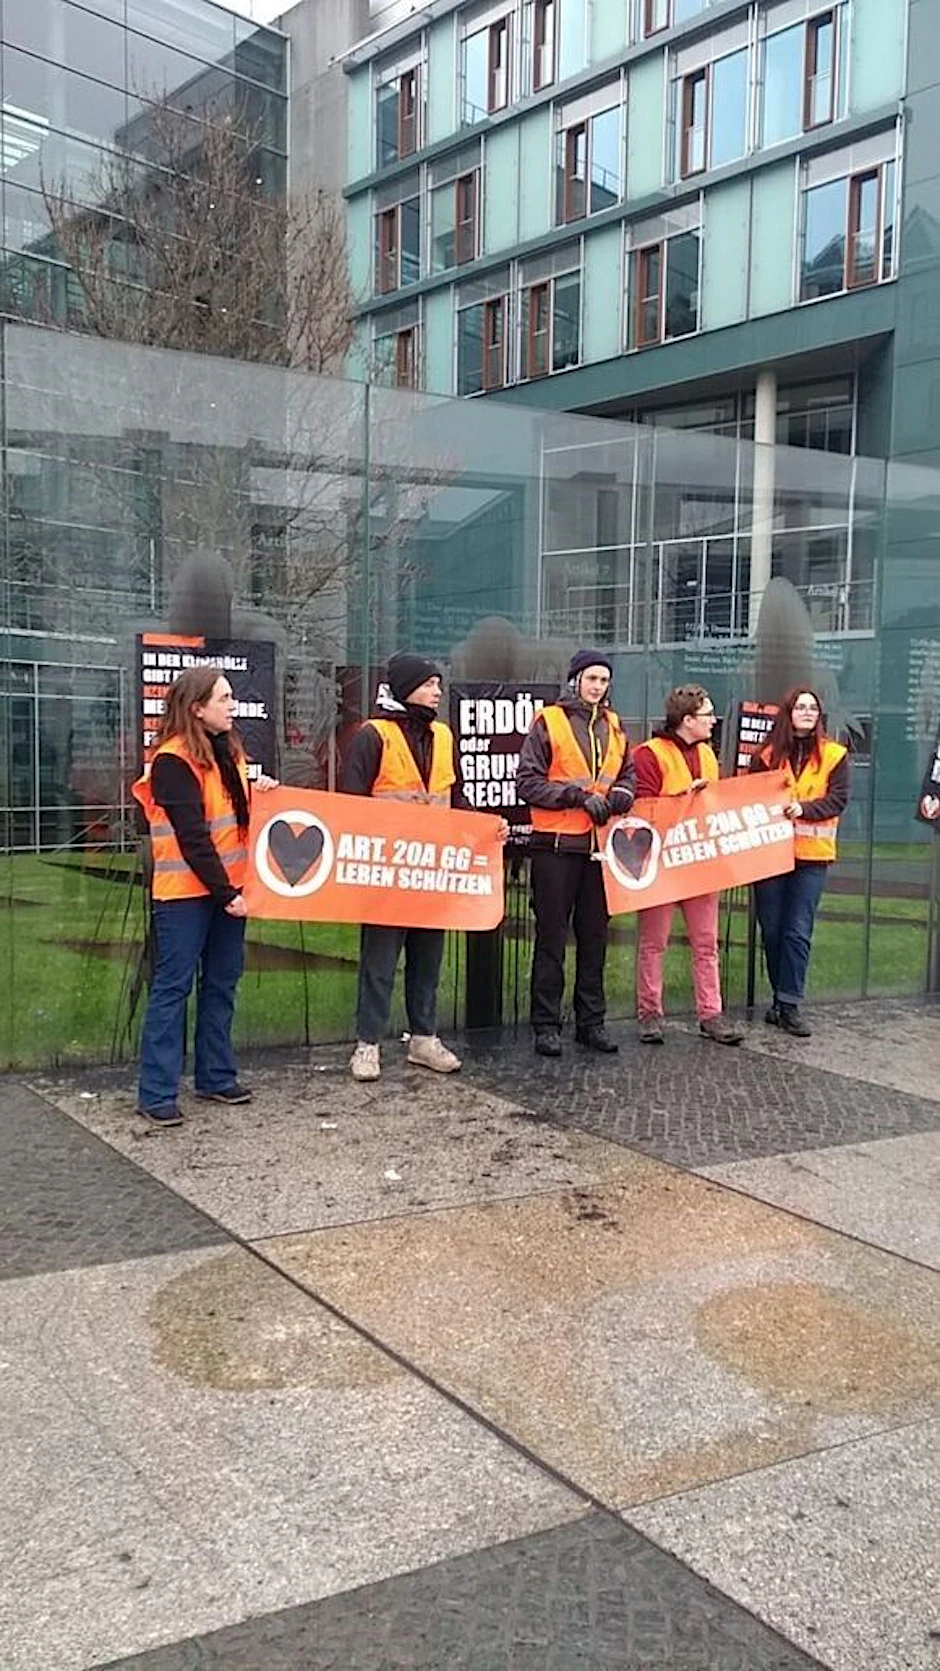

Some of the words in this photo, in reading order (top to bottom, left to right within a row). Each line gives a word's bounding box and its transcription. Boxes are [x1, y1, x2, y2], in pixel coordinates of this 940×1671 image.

[158, 653, 181, 668] DER
[459, 737, 490, 753] oder
[459, 753, 520, 781] GRUN
[462, 780, 527, 807] RECH
[337, 833, 387, 863] ART.
[391, 838, 436, 867] 20A
[440, 845, 472, 872] GG
[661, 838, 718, 869] LEBEN
[336, 860, 396, 888] LEBEN
[397, 867, 493, 896] SCHÜTZEN
